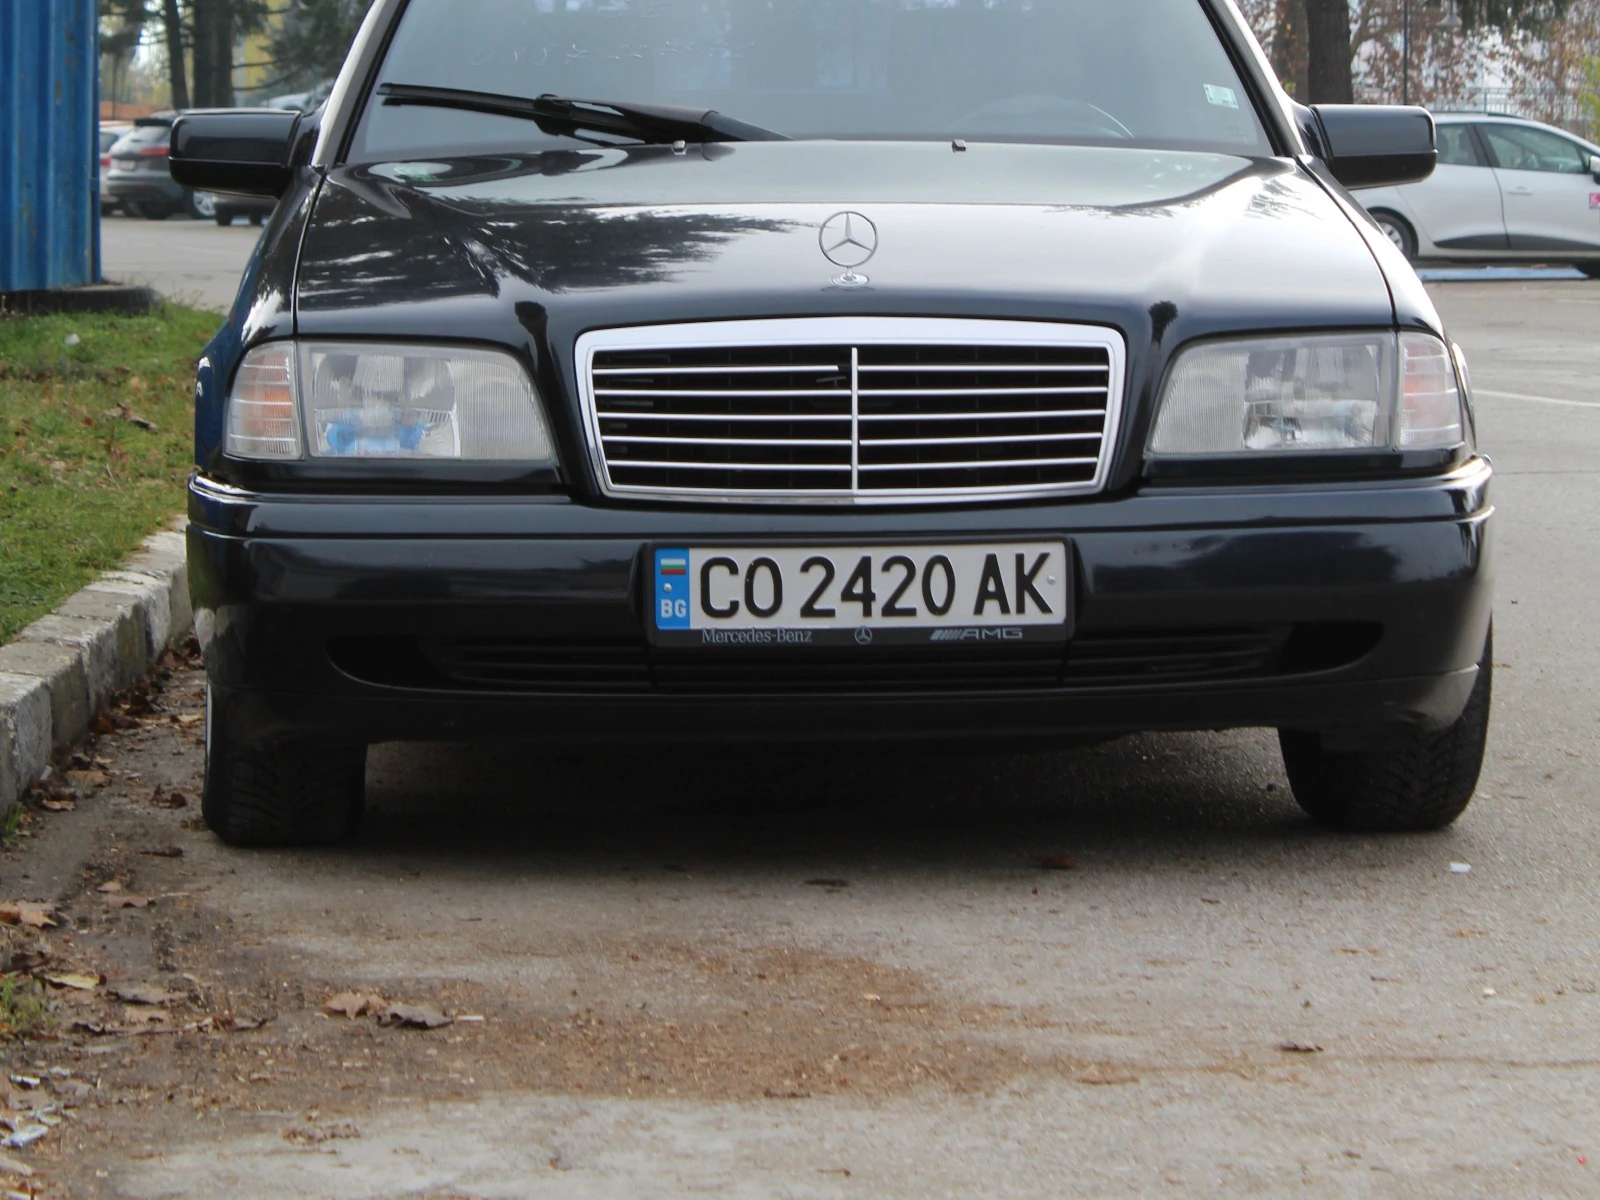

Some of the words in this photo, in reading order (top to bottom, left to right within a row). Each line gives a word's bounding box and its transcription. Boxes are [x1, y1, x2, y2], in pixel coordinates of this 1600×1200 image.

[700, 556, 783, 618] CO
[800, 554, 956, 618] 2420
[973, 552, 1054, 616] AK
[660, 599, 687, 618] BG
[702, 627, 814, 643] Mercedes-Benz
[960, 628, 1023, 640] AMG
